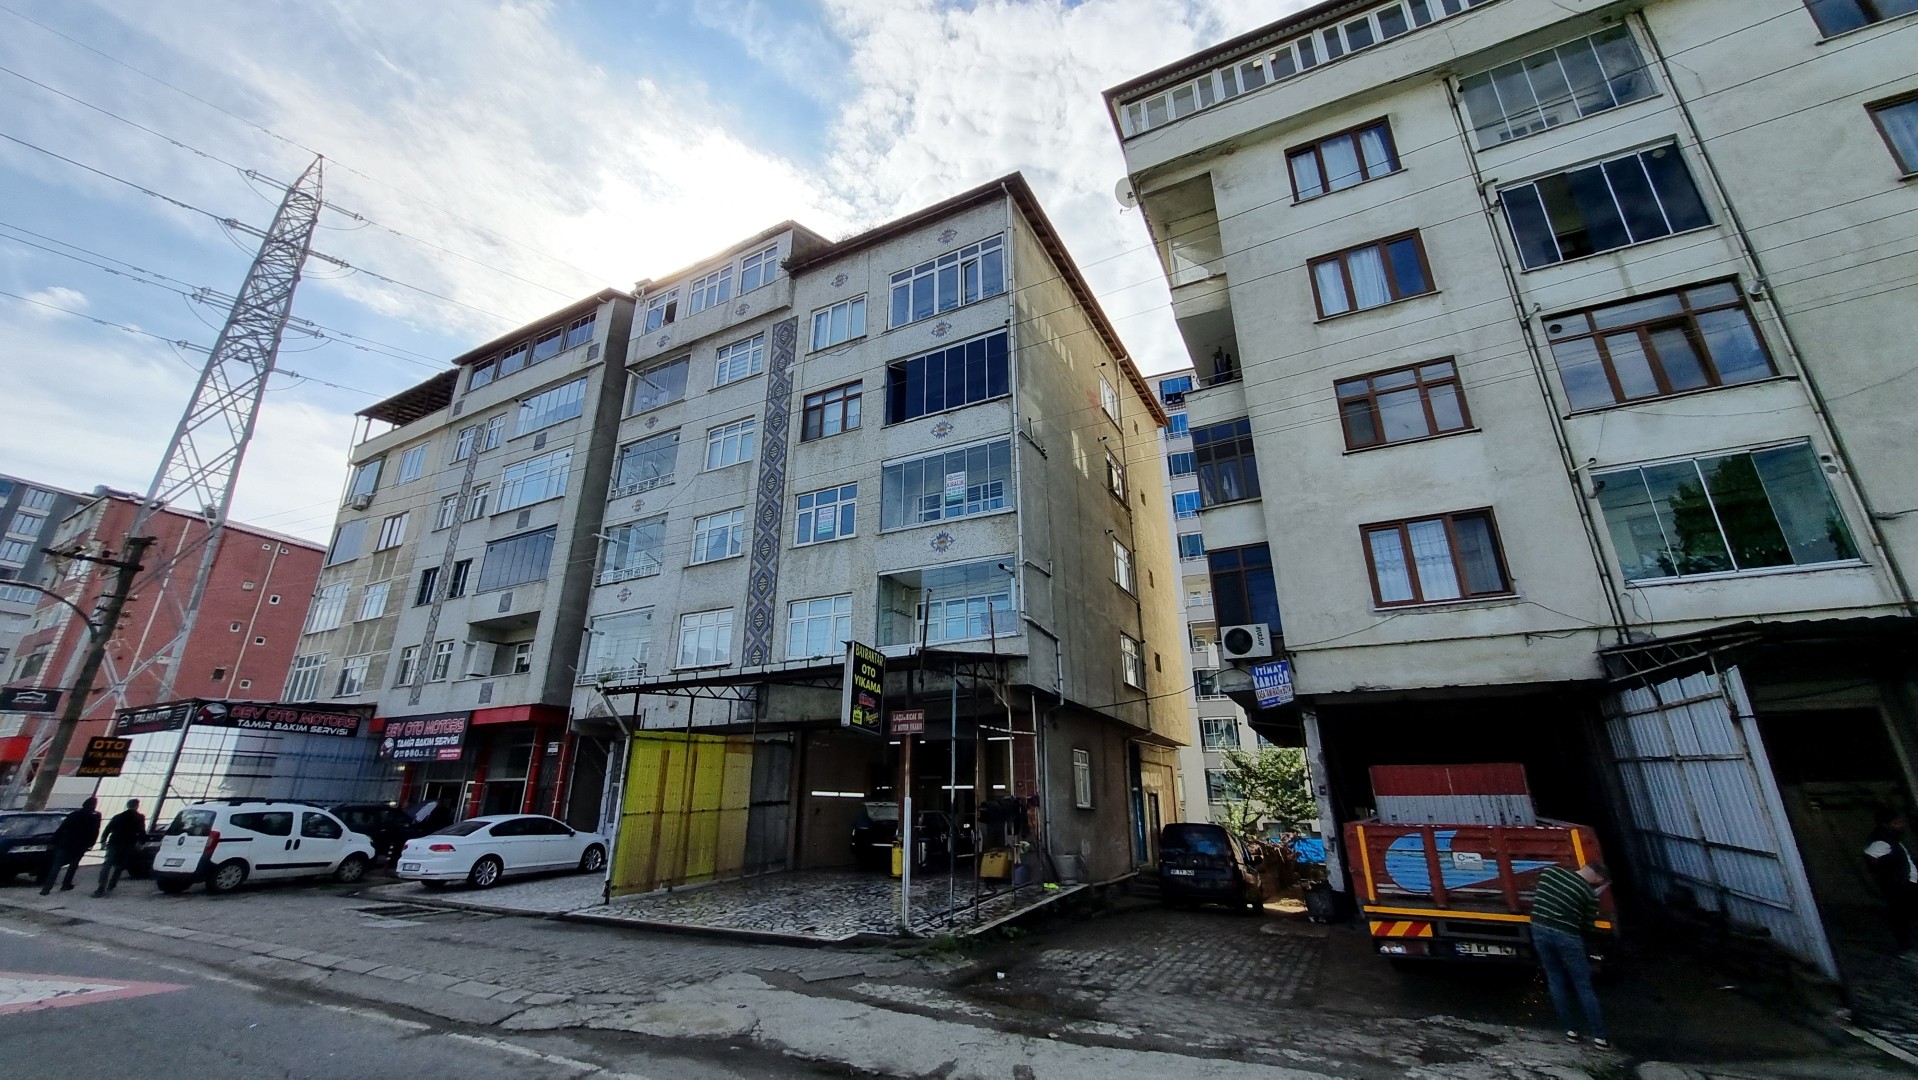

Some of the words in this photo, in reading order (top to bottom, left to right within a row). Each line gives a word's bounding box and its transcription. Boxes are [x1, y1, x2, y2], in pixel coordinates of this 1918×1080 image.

[861, 663, 876, 678] OTO
[854, 674, 881, 694] YIKAMA
[230, 705, 265, 719] DEV
[266, 708, 298, 722] OTO
[299, 713, 359, 729] MOTORS
[274, 722, 308, 732] BAKIM
[385, 722, 405, 737] DEV
[405, 721, 425, 736] OTO
[424, 718, 466, 735] MOTORS
[92, 739, 126, 750] OTO
[415, 737, 434, 747] BAKIM
